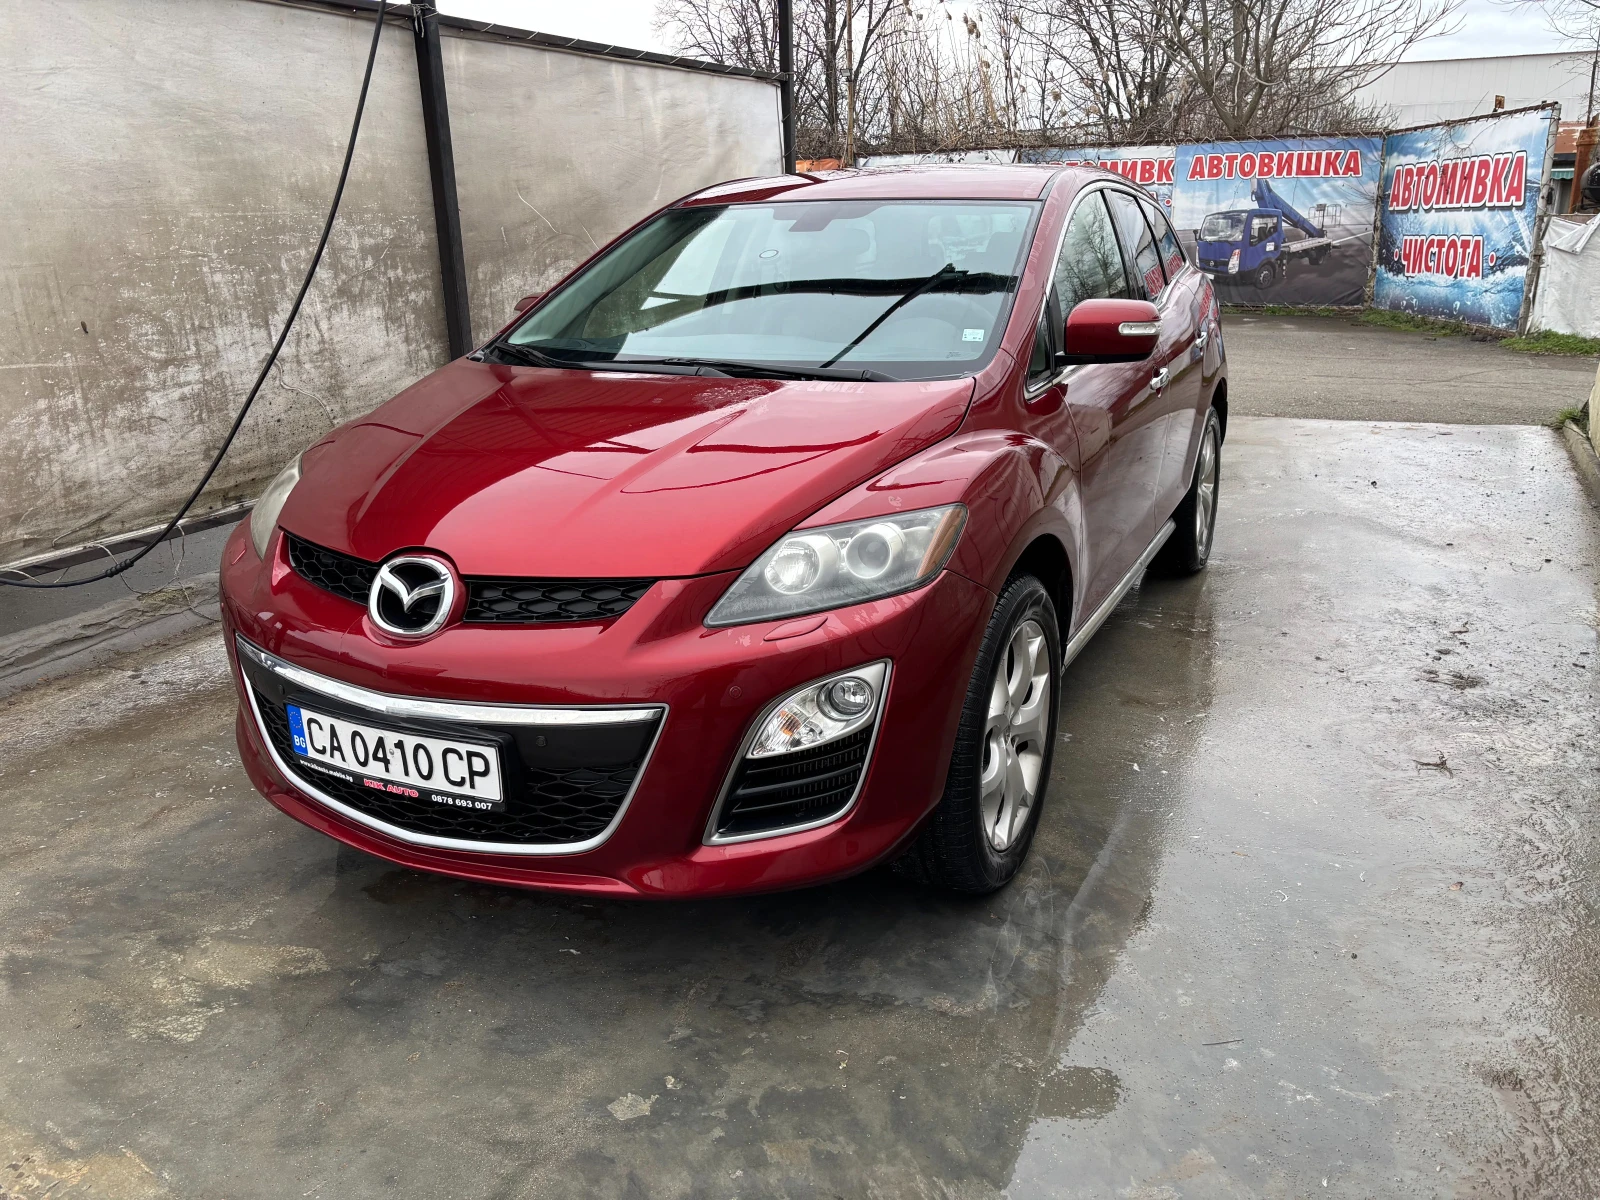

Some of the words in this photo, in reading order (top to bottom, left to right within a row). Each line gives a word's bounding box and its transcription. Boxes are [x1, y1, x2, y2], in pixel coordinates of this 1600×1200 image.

[1187, 149, 1362, 181] АВТОВИШКА
[1388, 151, 1527, 211] АВТОМИВКА
[1401, 234, 1484, 280] ЧИСТОТА
[293, 734, 306, 749] BG
[363, 778, 385, 791] KIK
[387, 785, 420, 798] AUTO
[431, 794, 453, 805] 0878
[455, 798, 473, 808] 693
[475, 801, 493, 810] 007
